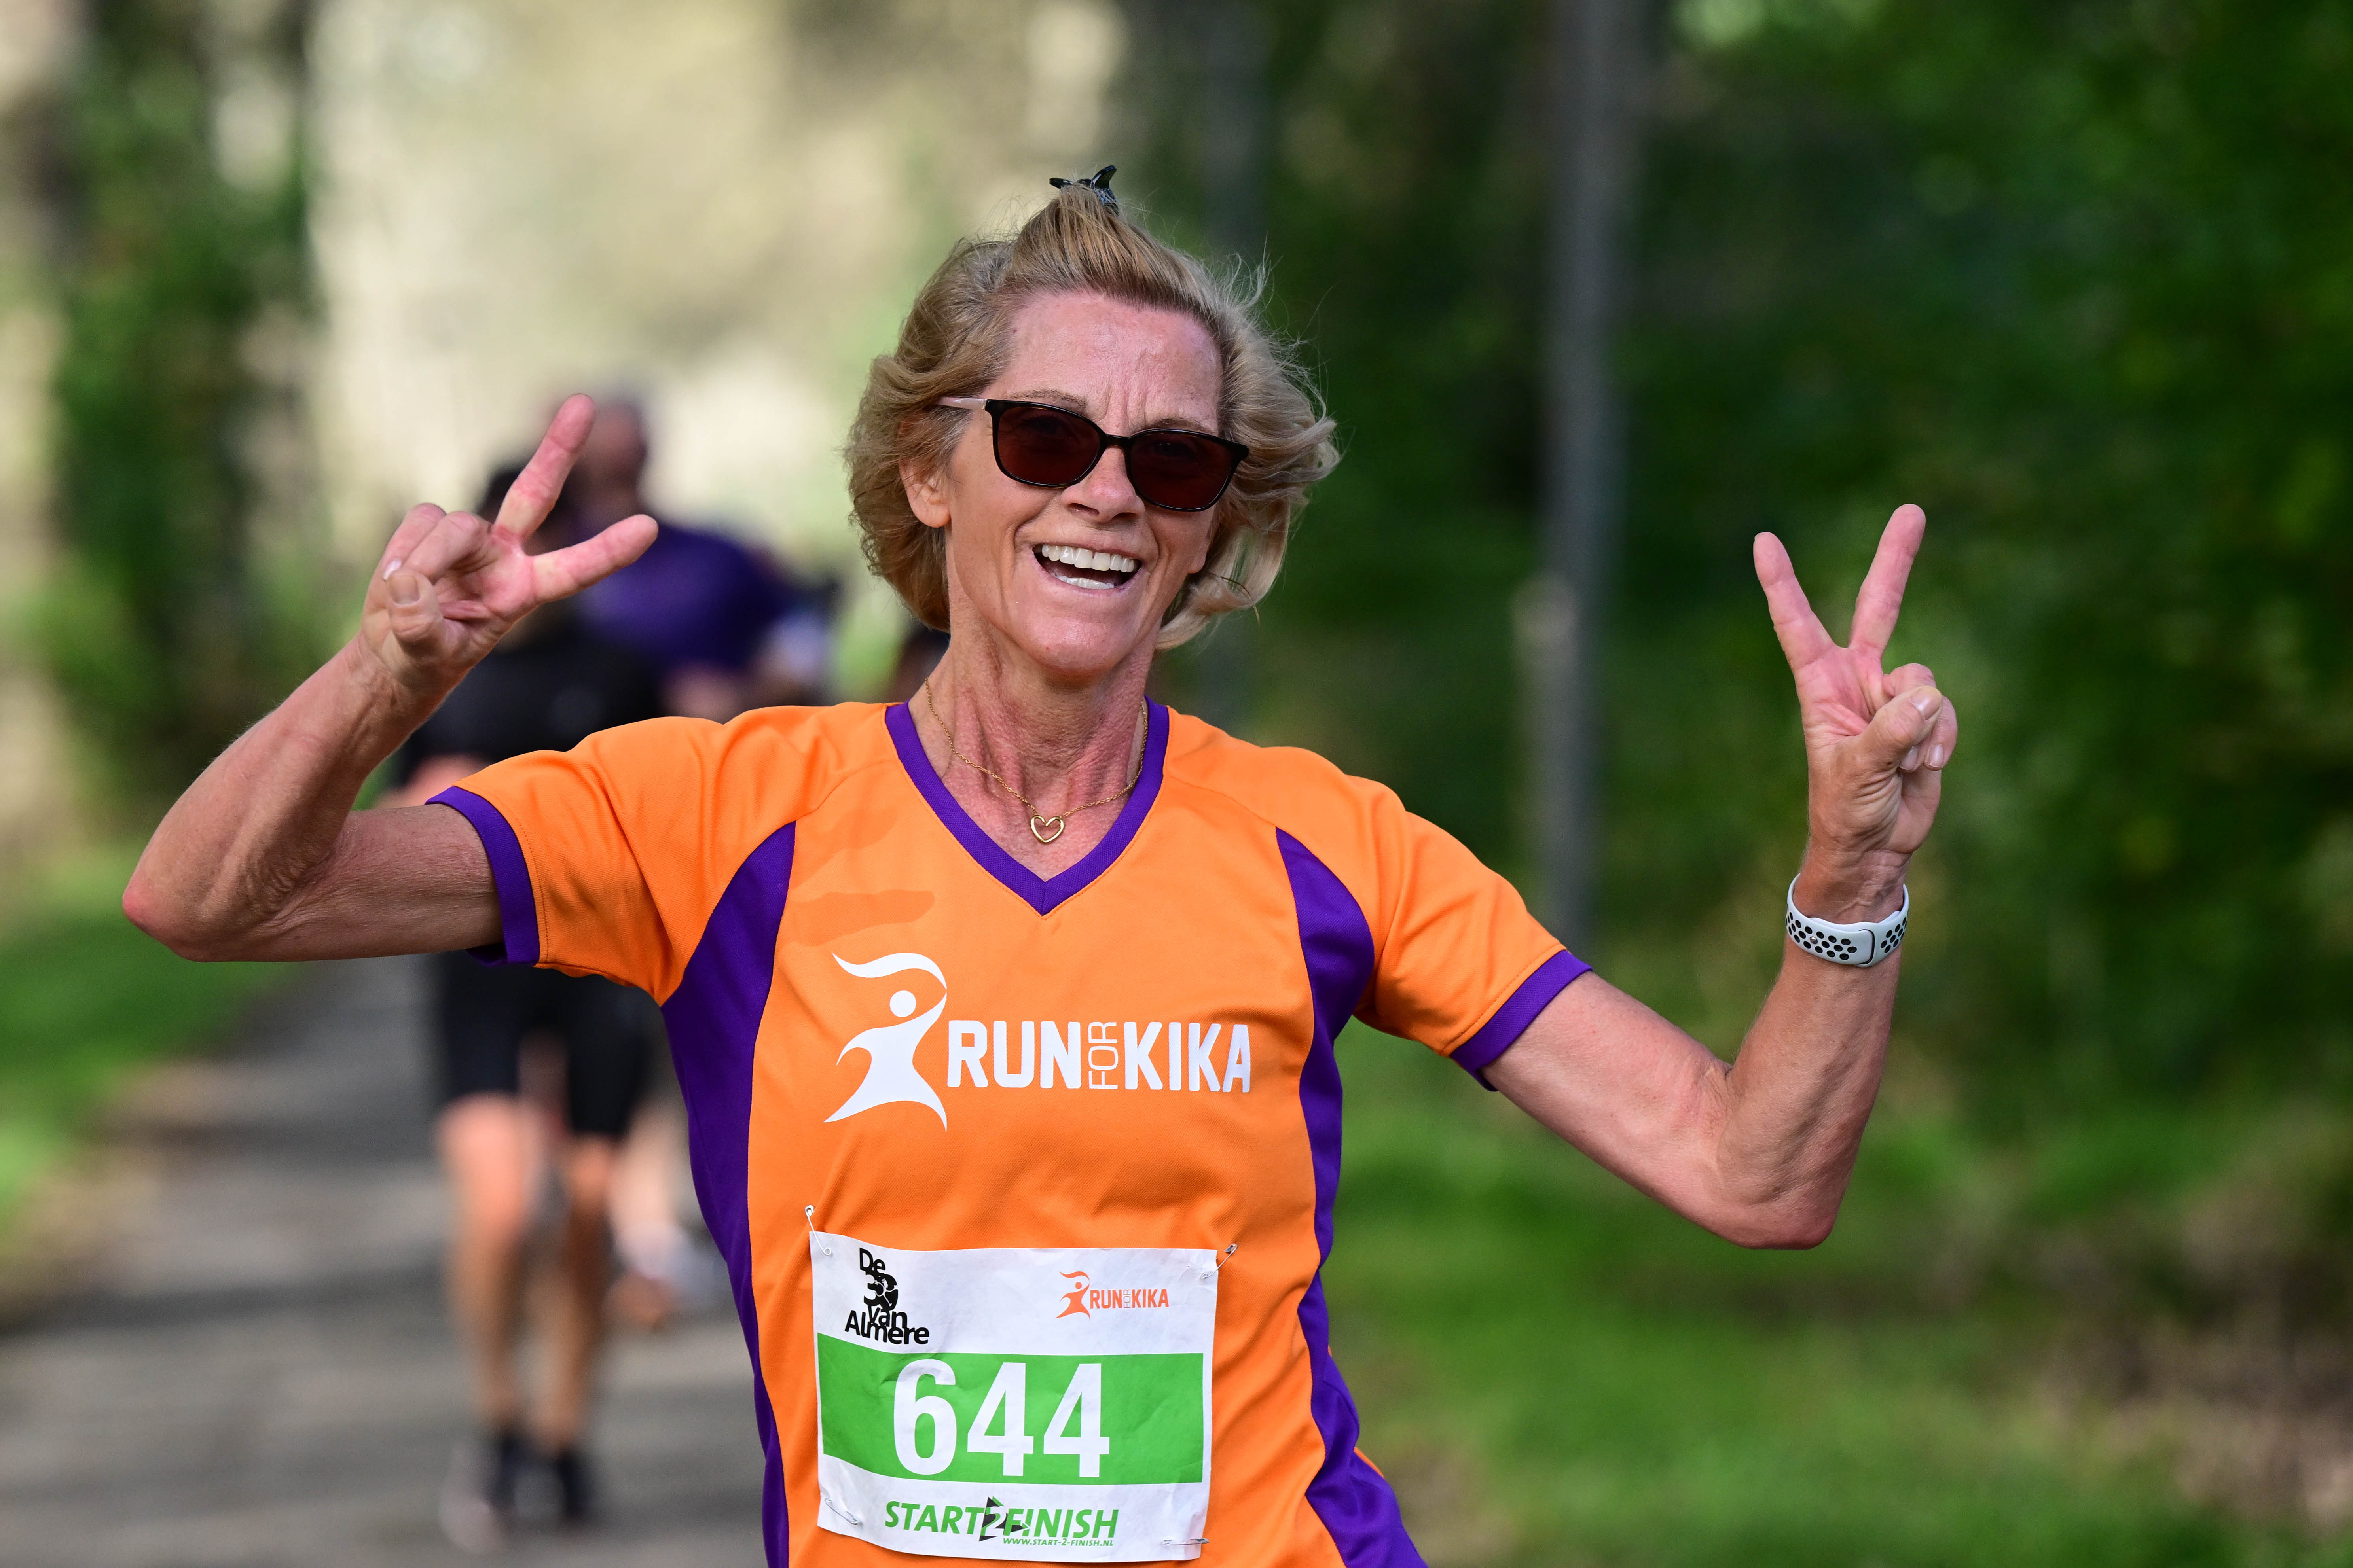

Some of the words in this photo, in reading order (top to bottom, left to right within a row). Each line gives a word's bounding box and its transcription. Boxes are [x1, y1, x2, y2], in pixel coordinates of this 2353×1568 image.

[947, 1020, 1081, 1089] RUN
[1088, 1021, 1119, 1090] FOR
[1124, 1021, 1251, 1093] KIKA
[859, 1247, 885, 1274] De
[1090, 1289, 1122, 1309] RUN
[1132, 1288, 1169, 1308] KIKA
[844, 1310, 929, 1345] Almere
[893, 1358, 1109, 1478] 644
[1003, 1538, 1114, 1546] WWW.START-2-FINISH.NL
